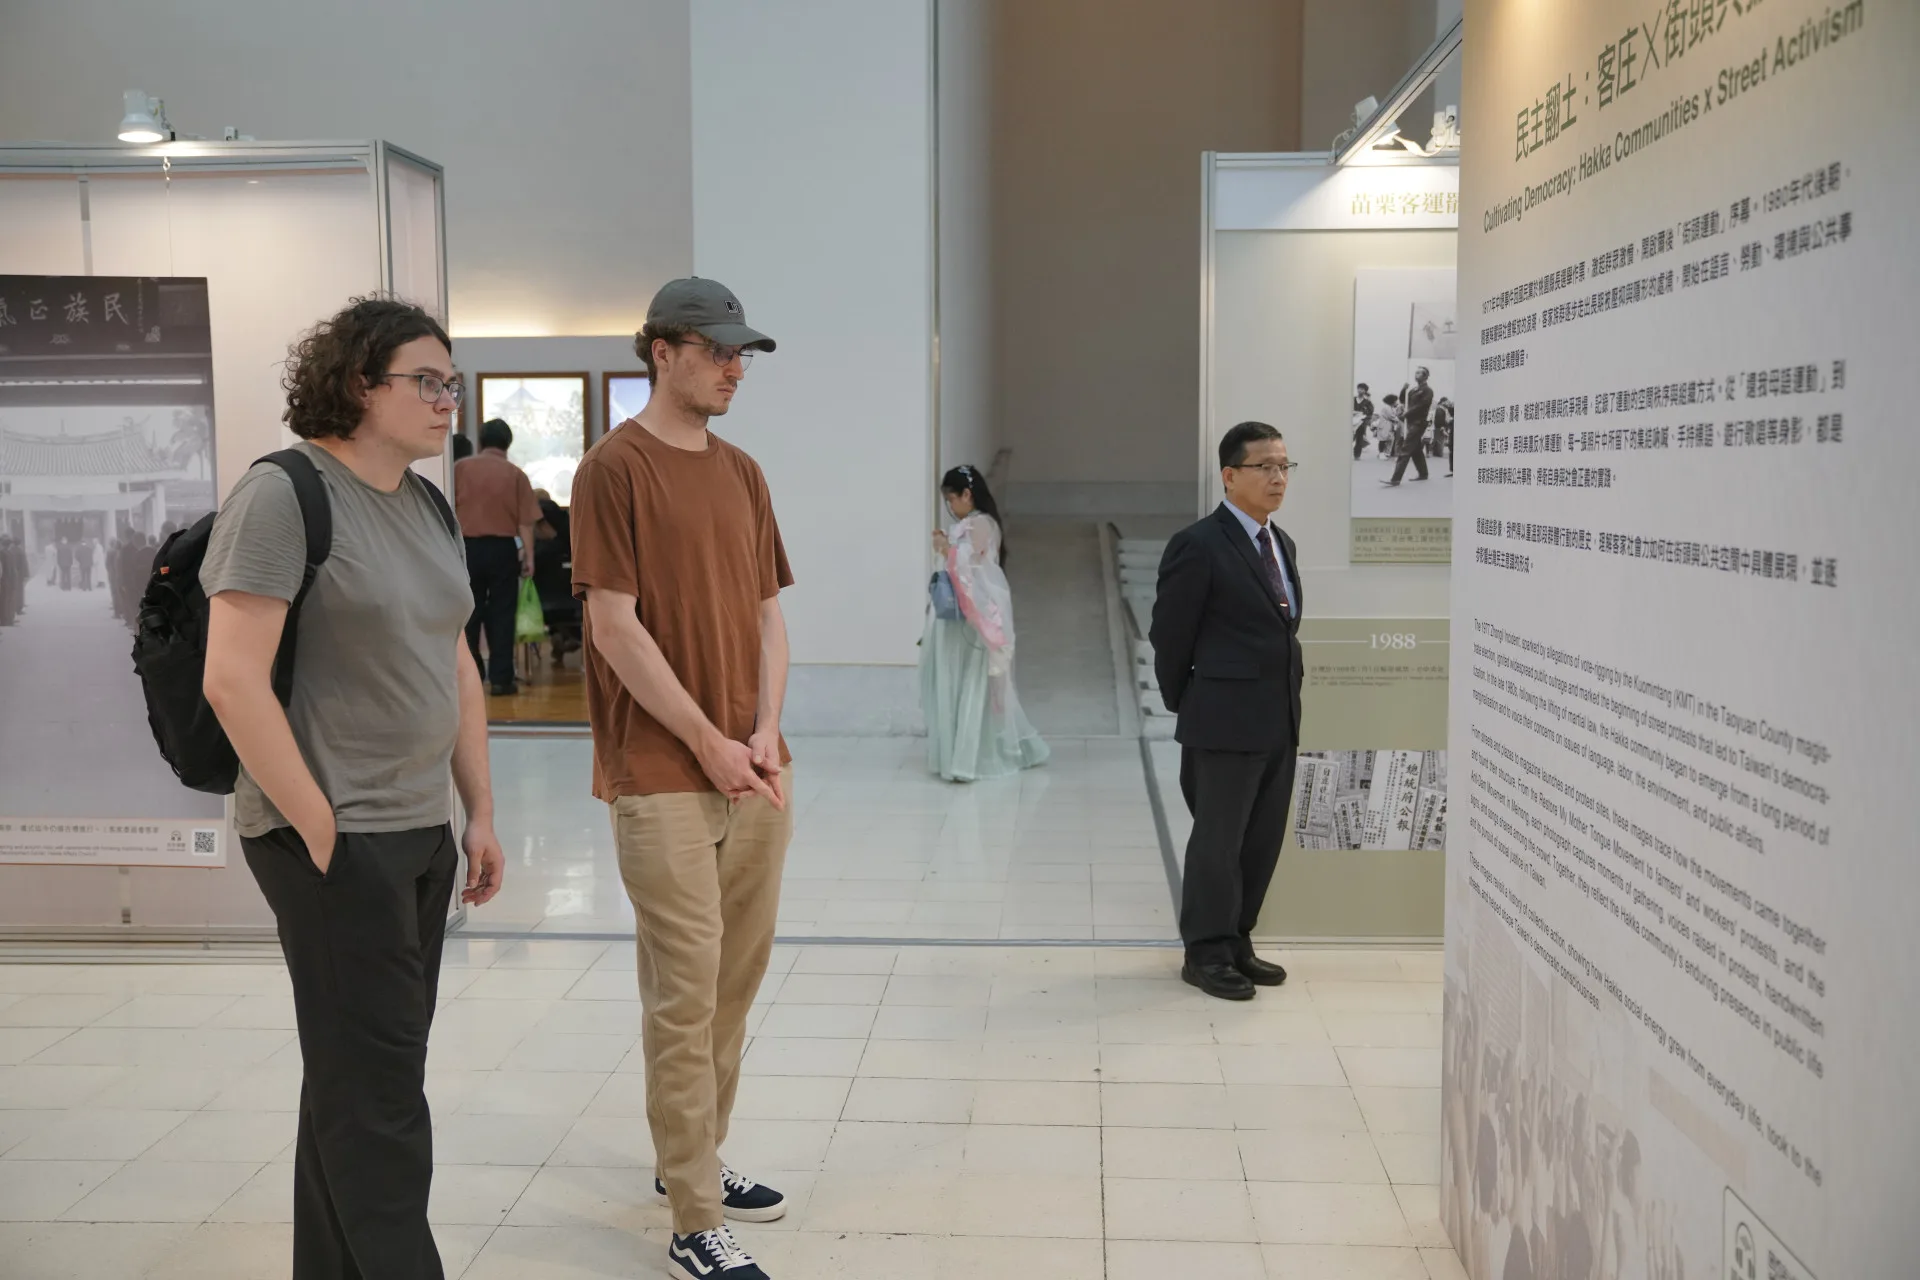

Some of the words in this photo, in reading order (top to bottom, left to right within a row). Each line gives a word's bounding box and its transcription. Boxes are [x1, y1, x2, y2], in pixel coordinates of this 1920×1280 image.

[1484, 196, 1521, 235] Cultivating
[1524, 164, 1575, 213] Democracy:
[1579, 141, 1610, 183] Hakka
[1614, 92, 1698, 164] Communities
[1703, 85, 1711, 115] x
[1717, 44, 1766, 108] Street
[1772, 0, 1863, 77] Activism
[1370, 632, 1417, 651] 1988
[1581, 658, 1612, 687] vote-rigging
[1633, 674, 1671, 709] Kuomintang
[1673, 688, 1695, 719] (KMT)
[1720, 705, 1756, 737] Taoyuan
[1563, 733, 1579, 756] issues
[1709, 812, 1732, 837] public
[1568, 711, 1585, 729] martial
[1609, 726, 1627, 750] Hakka
[1630, 740, 1663, 772] community
[1666, 751, 1686, 779] began
[1699, 772, 1727, 801] emerge
[1730, 781, 1749, 808] from
[1761, 794, 1780, 829] long
[1579, 687, 1598, 706] marked
[1610, 696, 1638, 728] beginning
[1648, 713, 1666, 735] street
[1668, 724, 1696, 748] protests
[1698, 731, 1712, 755] that
[1739, 748, 1778, 783] Taiwan's
[1569, 811, 1586, 837] Mother
[1589, 824, 1609, 853] Tongue
[1612, 839, 1643, 876] Movement
[1655, 867, 1683, 901] farmers'
[1704, 904, 1737, 938] workers'
[1572, 846, 1594, 872] captures
[1597, 863, 1622, 892] moments
[1667, 914, 1689, 941] voices
[1693, 931, 1716, 960] raised
[1575, 791, 1593, 813] protest
[1612, 808, 1627, 834] these
[1630, 819, 1652, 849] images
[1654, 834, 1671, 861] trace
[1704, 869, 1751, 911] movements
[1754, 900, 1779, 928] came
[1578, 874, 1589, 901] they
[1591, 888, 1608, 912] reflect
[1620, 906, 1639, 937] Hakka
[1641, 927, 1682, 971] community's
[1685, 961, 1718, 1004] enduring
[1721, 988, 1760, 1031] presence
[1568, 942, 1589, 978] showing
[1604, 972, 1622, 1004] Hakka
[1624, 995, 1642, 1022] social
[1644, 1013, 1666, 1049] energy
[1668, 1035, 1685, 1062] grew
[1688, 1047, 1704, 1080] from
[1708, 1071, 1745, 1123] everyday
